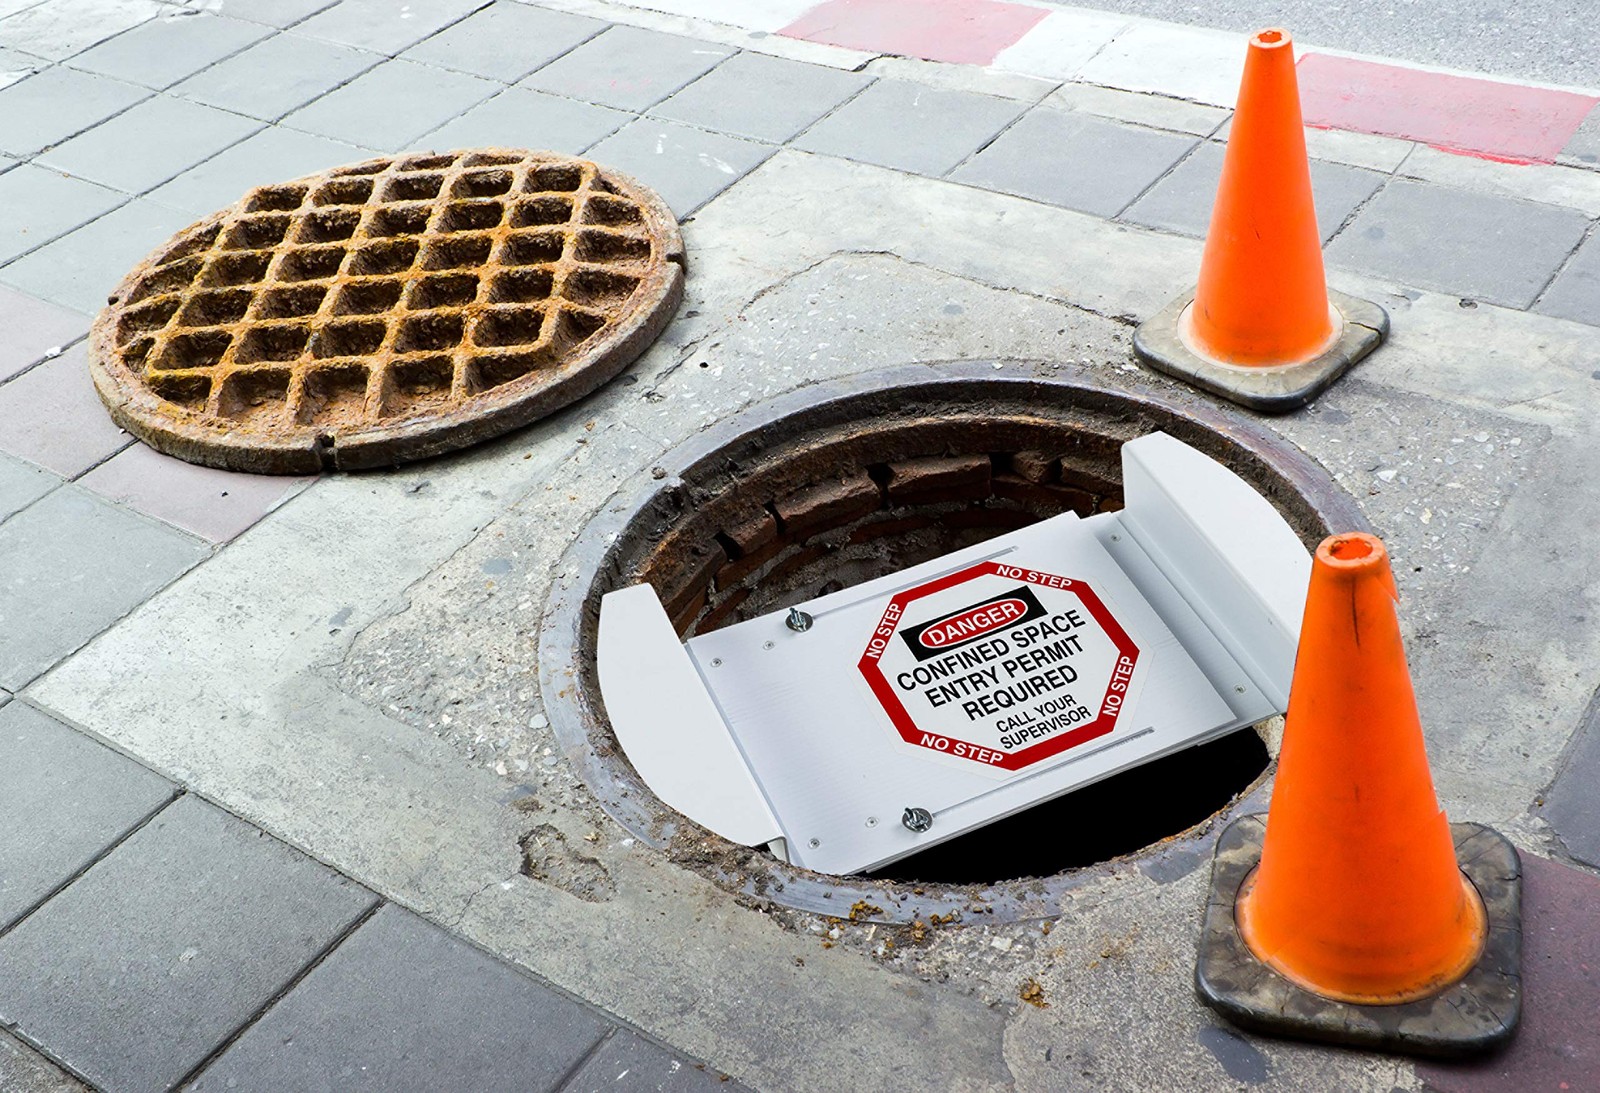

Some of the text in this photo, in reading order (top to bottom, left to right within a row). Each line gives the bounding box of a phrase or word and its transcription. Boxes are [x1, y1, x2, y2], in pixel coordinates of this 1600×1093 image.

[996, 566, 1072, 589] NO STEP
[866, 603, 901, 658] NO STEP
[928, 602, 1020, 645] DANGER
[897, 610, 1086, 691] CONFINED SPACE
[924, 634, 1084, 708] ENTRY PERMIT
[962, 665, 1078, 720] REQUIRED
[1102, 656, 1133, 716] NO STEP
[996, 694, 1076, 732] CALL YOUR
[1000, 706, 1092, 749] SUPERVISOR
[920, 734, 1003, 765] NO STEP
